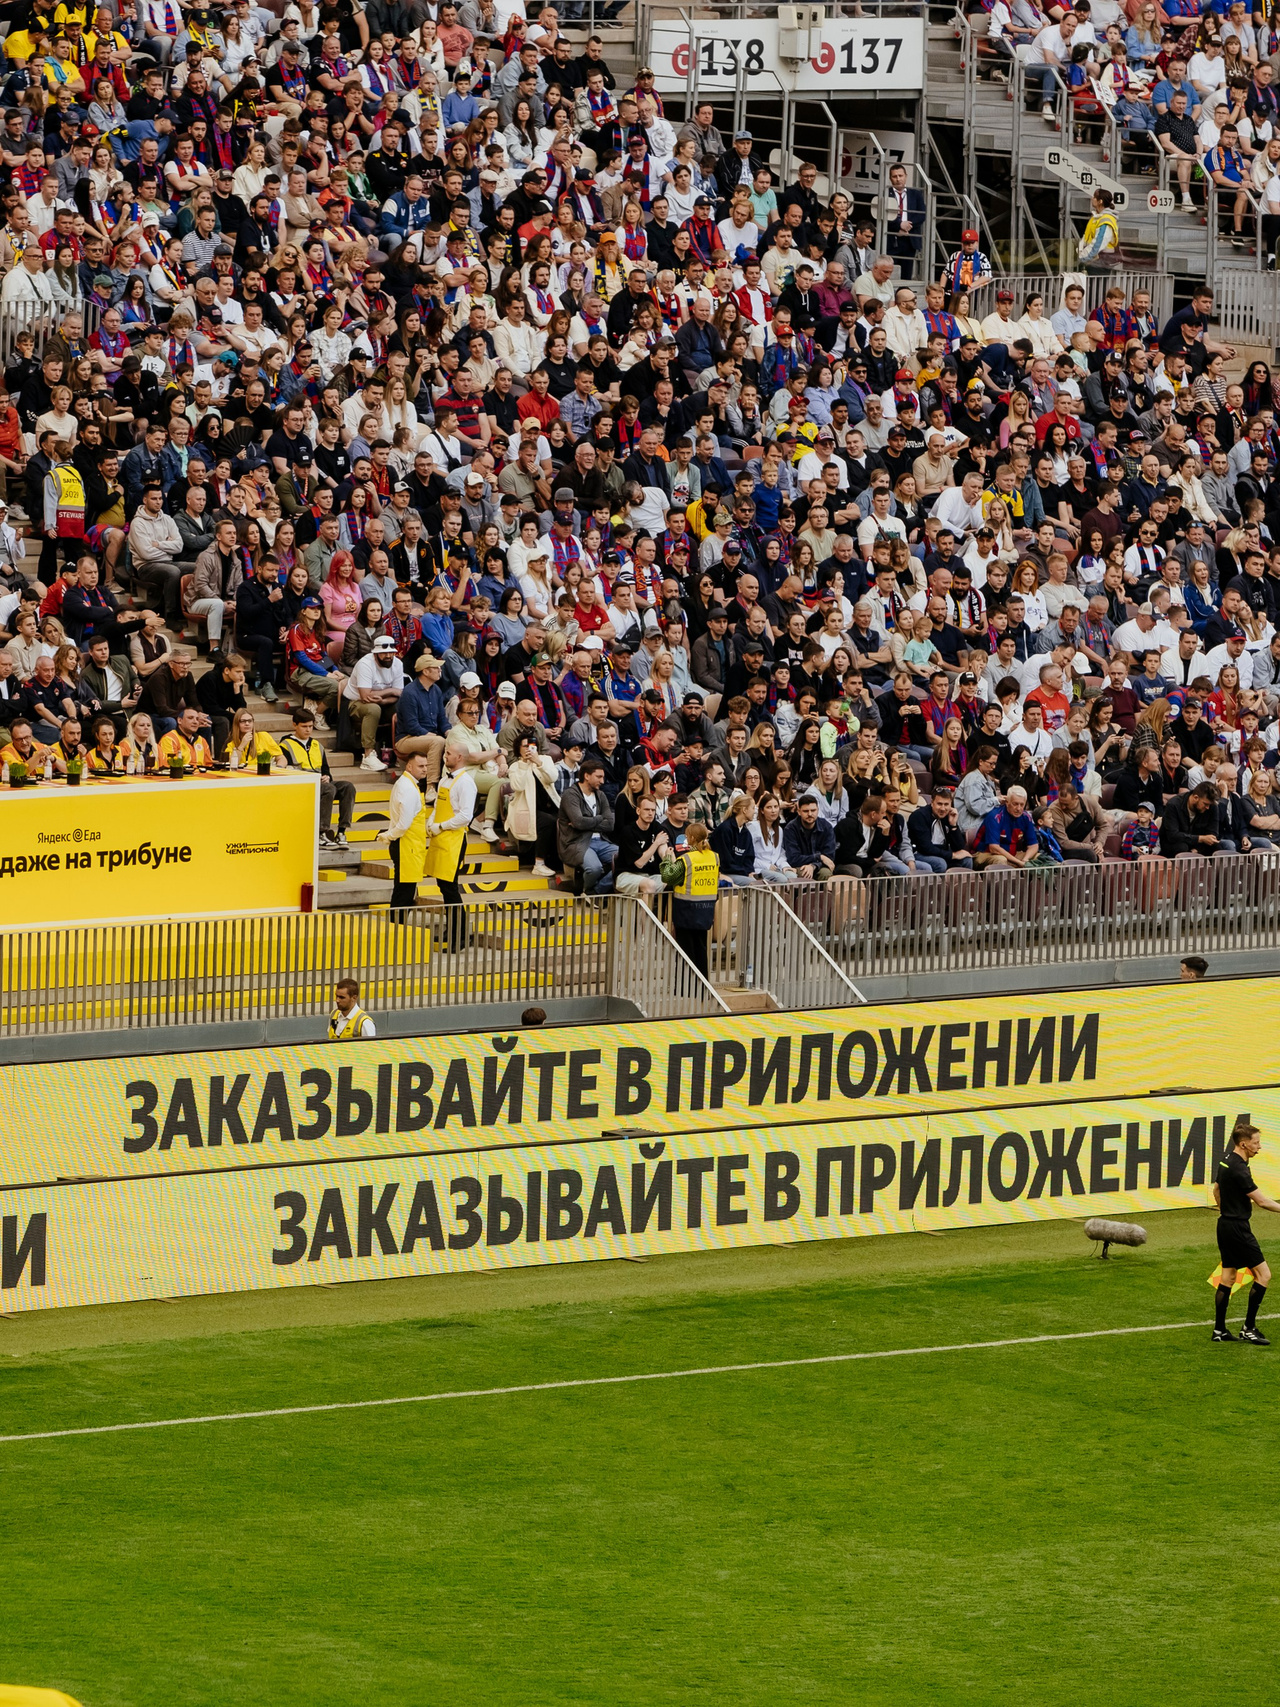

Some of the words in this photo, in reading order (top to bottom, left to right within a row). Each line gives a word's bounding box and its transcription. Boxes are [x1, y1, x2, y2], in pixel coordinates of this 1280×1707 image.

[701, 38, 764, 76] 138
[839, 37, 903, 74] 137
[1049, 154, 1059, 164] 41
[1082, 174, 1091, 183] 18
[1159, 198, 1172, 207] 137
[37, 832, 71, 844] Яндекс
[83, 829, 101, 842] Еда
[65, 851, 92, 870] на
[96, 841, 192, 873] трибуне
[225, 847, 279, 855] ЧЕМПИОНОВ
[694, 864, 716, 872] SAFETY
[694, 878, 716, 887] K0763
[123, 1036, 601, 1154] ЗАКАЗЫВАЙТЕ
[615, 1046, 652, 1116] В
[666, 1012, 1100, 1113] ПРИЛОЖЕНИИ
[272, 1141, 749, 1265] ЗАКАЗЫВАЙТЕ
[763, 1150, 801, 1222] В
